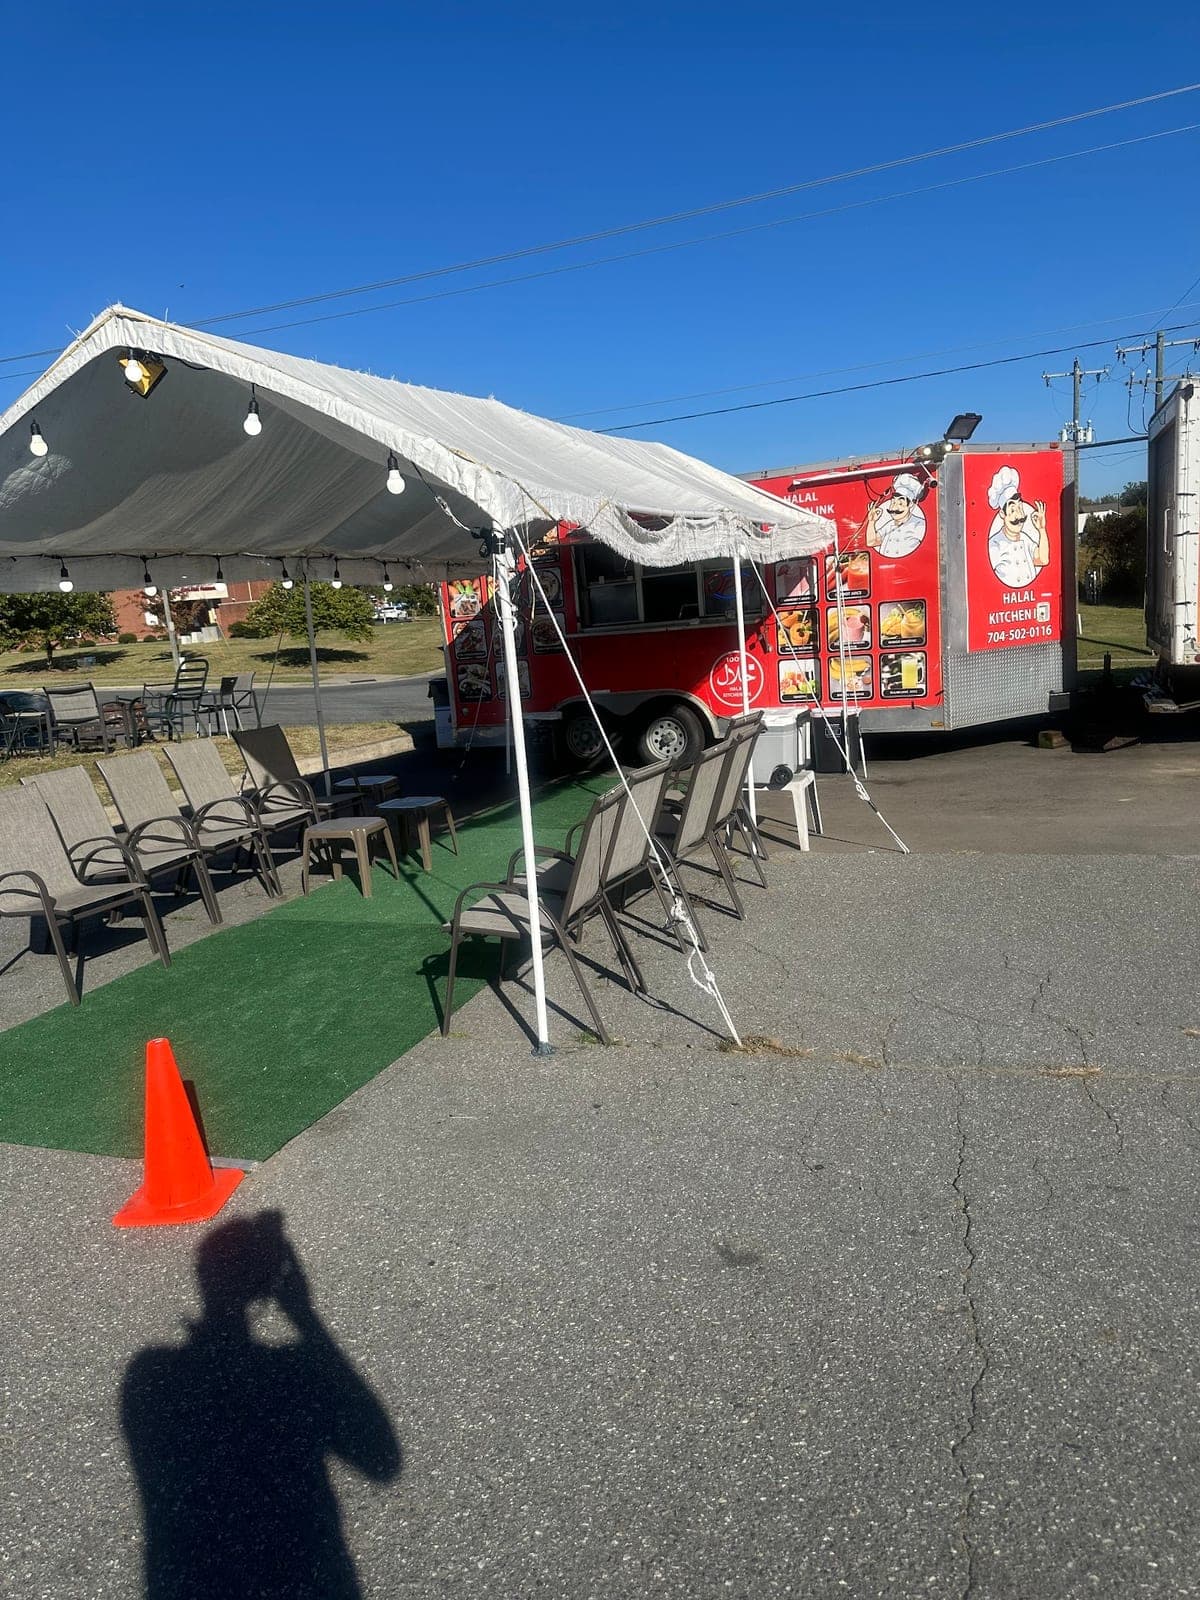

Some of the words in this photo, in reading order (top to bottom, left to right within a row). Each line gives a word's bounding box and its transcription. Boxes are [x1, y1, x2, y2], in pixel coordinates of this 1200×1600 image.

[783, 491, 819, 504] HALAL
[1003, 590, 1036, 605] HALAL
[988, 608, 1032, 625] KITCHEN
[987, 624, 1052, 644] 704-502-0116
